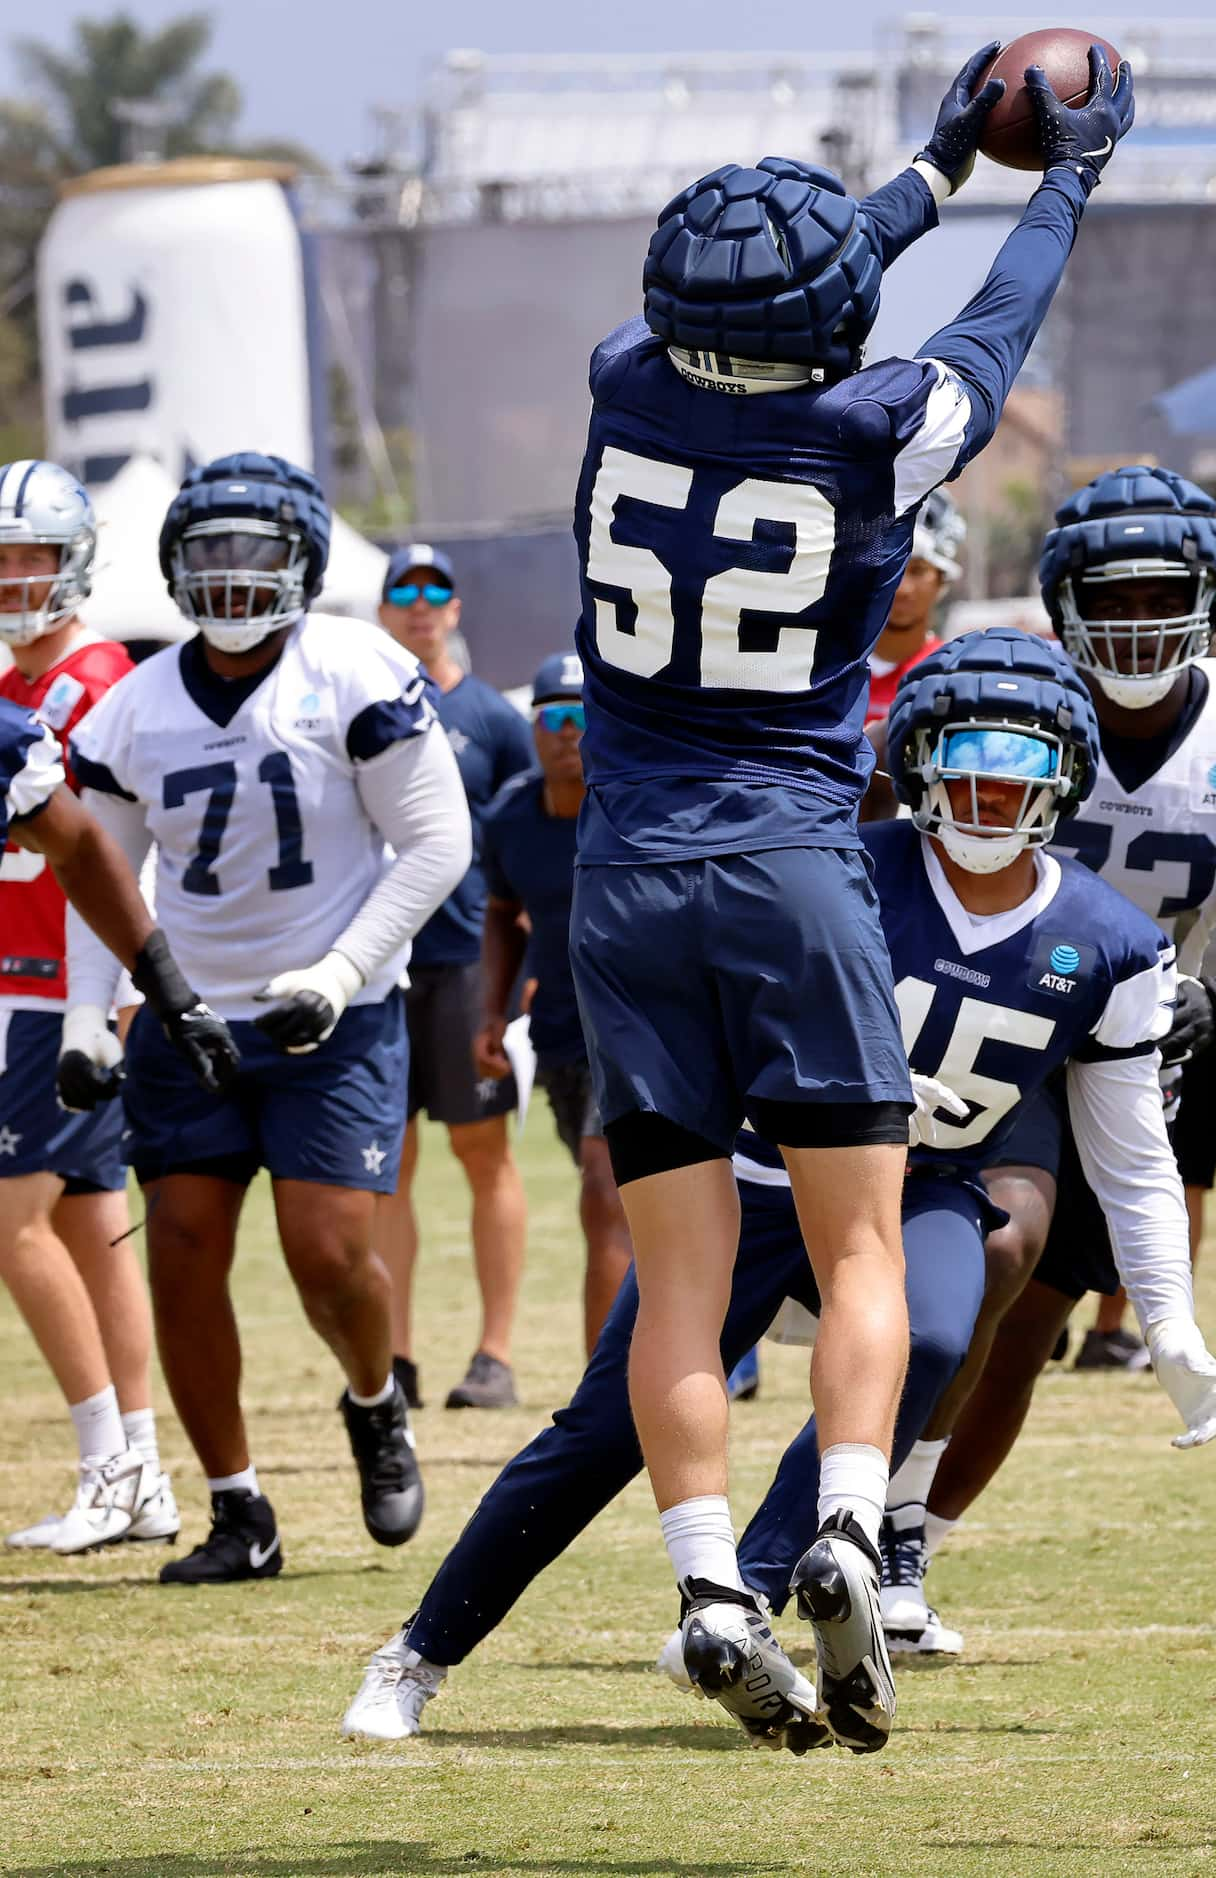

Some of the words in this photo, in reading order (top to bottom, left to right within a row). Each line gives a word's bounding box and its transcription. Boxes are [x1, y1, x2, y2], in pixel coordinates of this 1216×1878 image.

[680, 367, 747, 394] COWBOYS
[586, 445, 836, 691] 52
[1099, 800, 1153, 817] COWBOYS
[163, 751, 314, 896] 71
[934, 958, 991, 988] COWBOYS
[1039, 973, 1077, 993] AT&T
